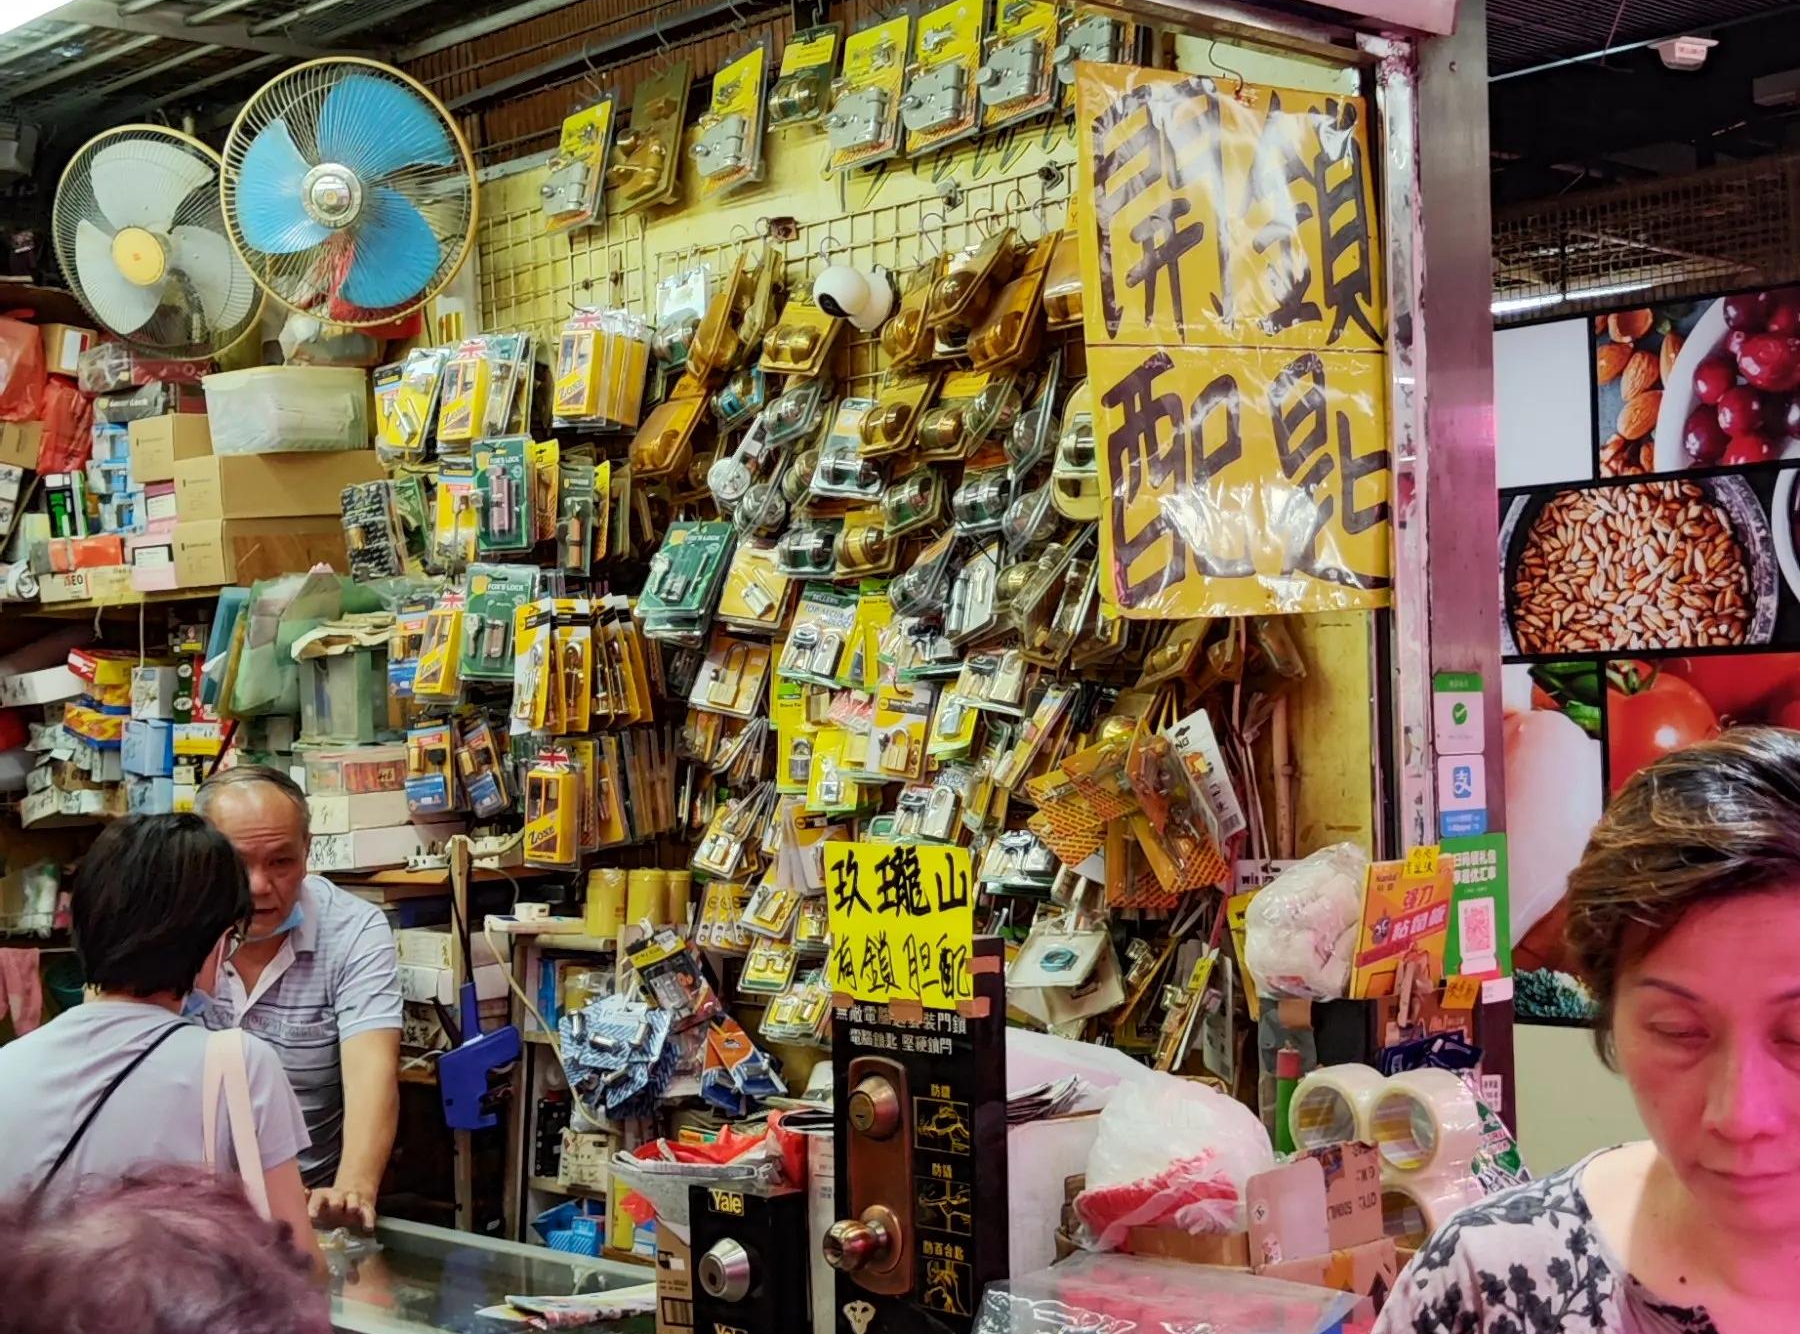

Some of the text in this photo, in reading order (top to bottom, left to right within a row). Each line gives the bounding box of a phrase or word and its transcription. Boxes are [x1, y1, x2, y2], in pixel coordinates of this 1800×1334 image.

[1092, 75, 1386, 348] 開鎖
[1101, 351, 1391, 610] 配匙
[831, 844, 968, 918] 玖瓏山
[711, 1188, 743, 1215] Yale
